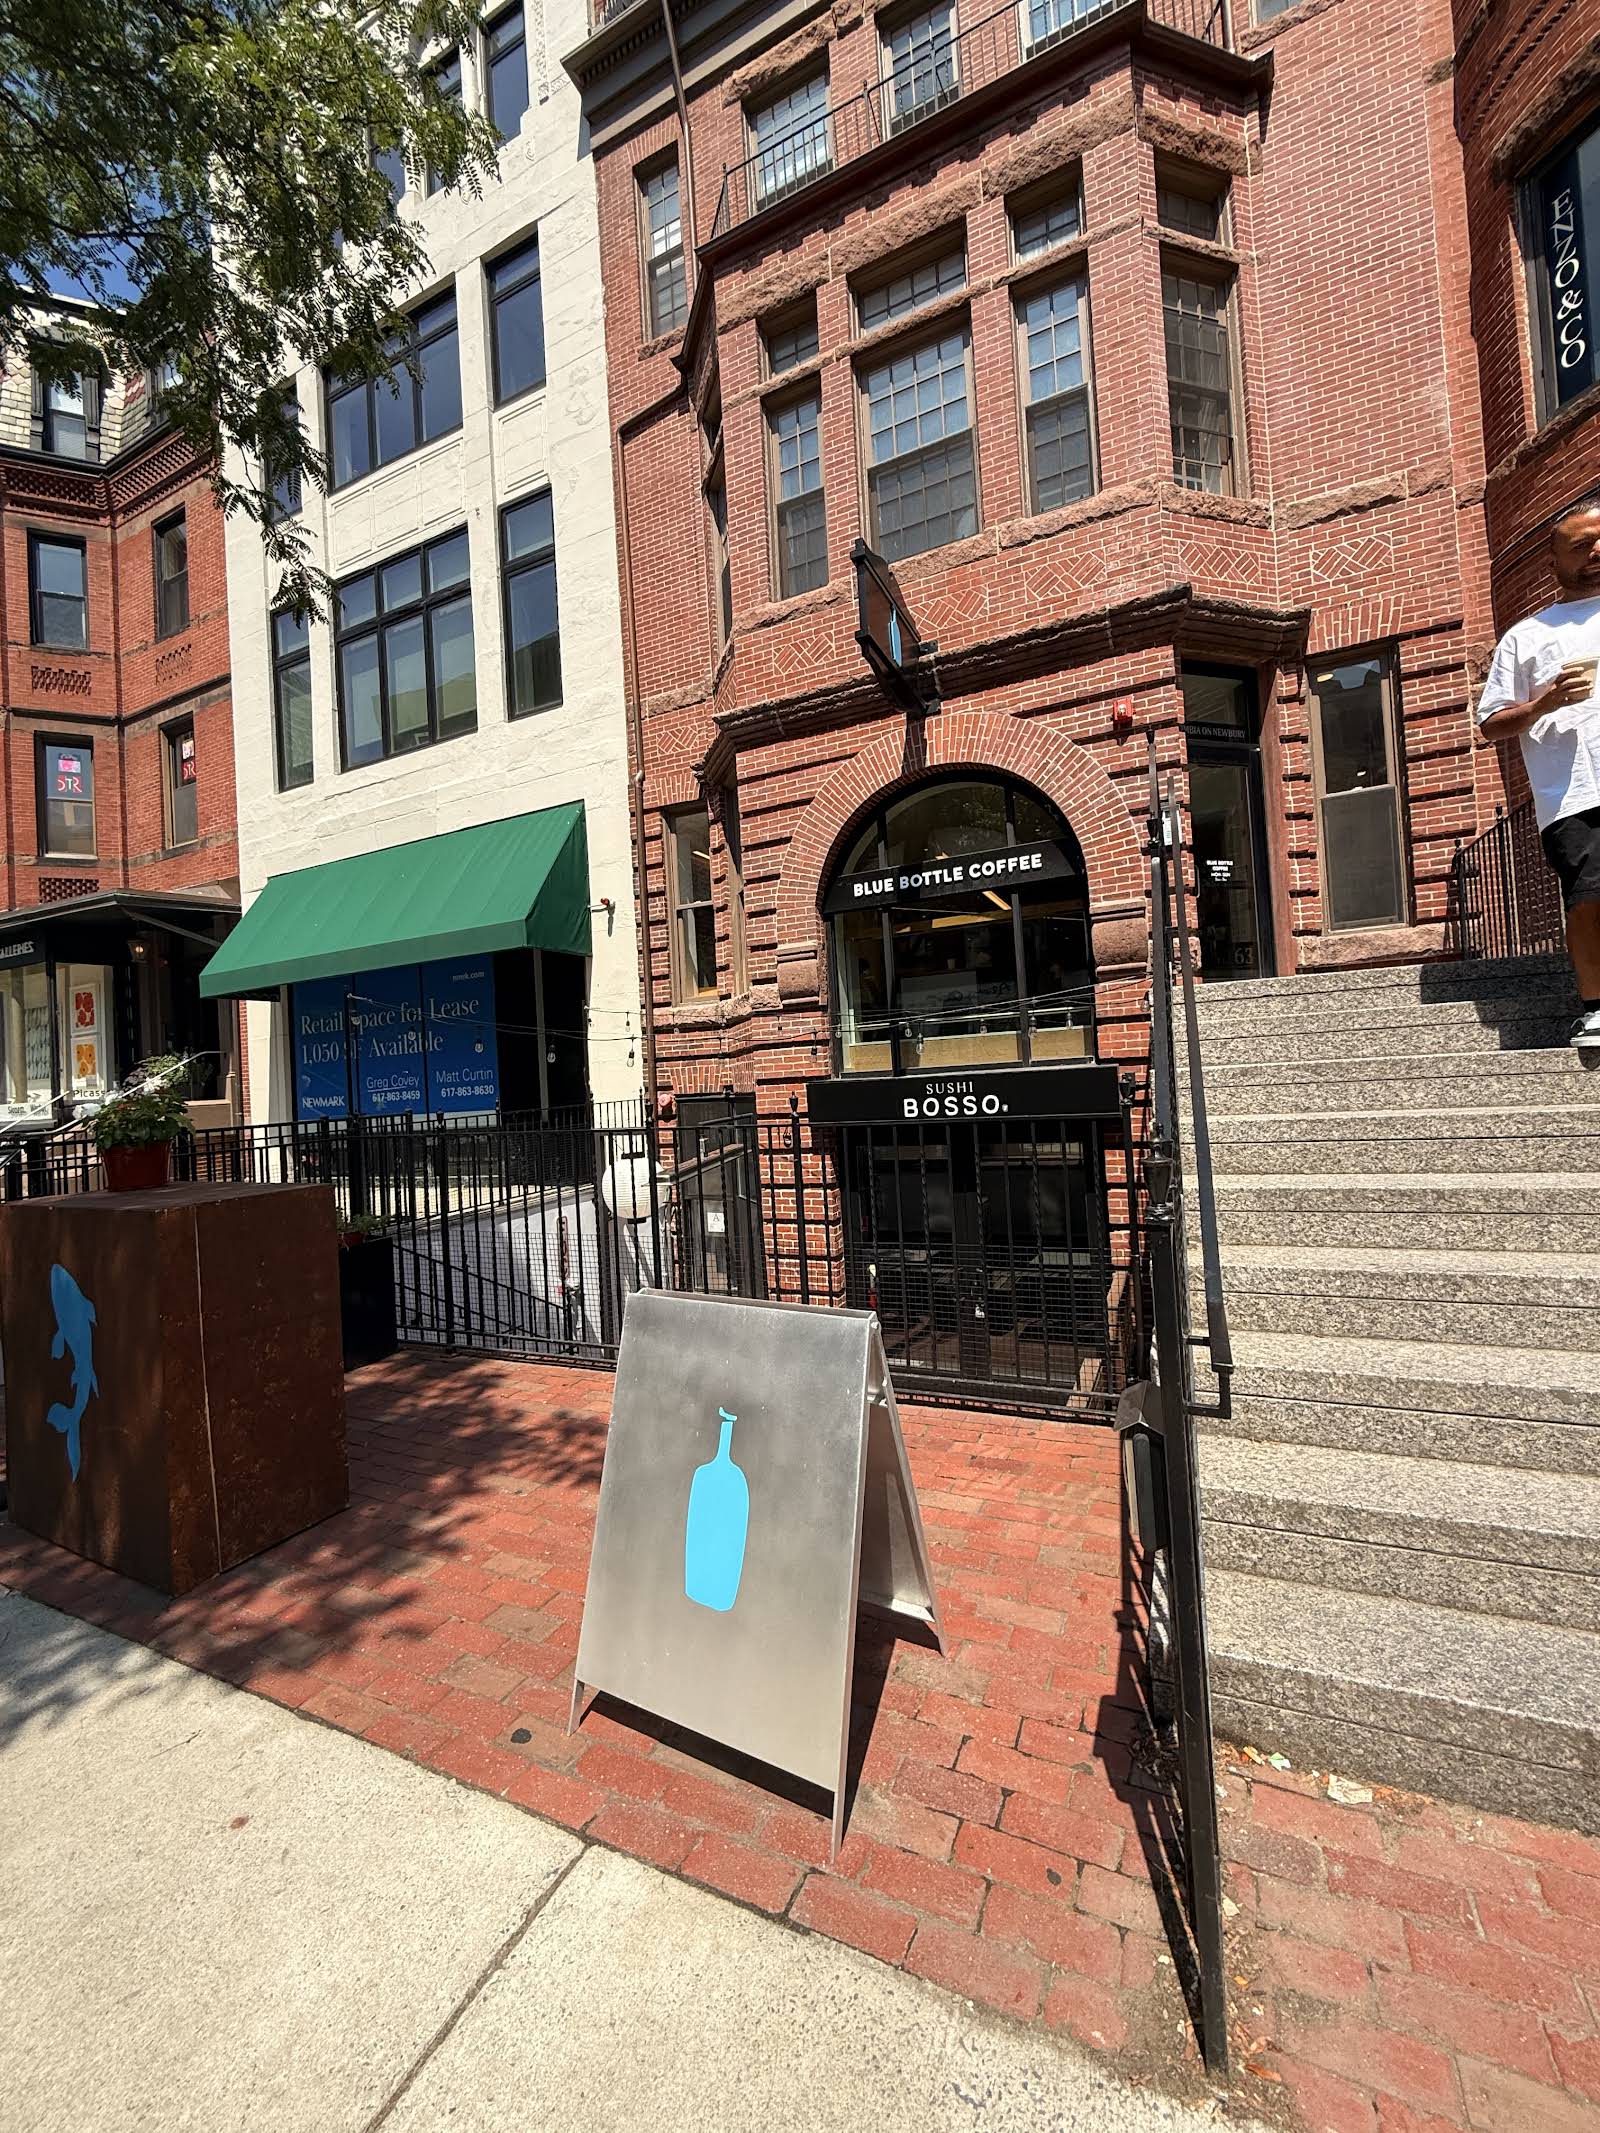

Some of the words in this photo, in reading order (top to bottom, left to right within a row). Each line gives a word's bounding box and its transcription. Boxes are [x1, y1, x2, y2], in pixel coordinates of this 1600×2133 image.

[1212, 727, 1246, 739] NEWBURY
[853, 878, 894, 897] BLUE
[899, 866, 964, 890] BOTTLE
[968, 853, 1043, 879] COFFEE
[301, 1011, 344, 1035] Retail
[350, 1009, 396, 1035] pace
[400, 1001, 423, 1023] for
[430, 998, 479, 1020] Lease
[302, 1040, 339, 1065] 1,050
[369, 1030, 444, 1058] Available
[366, 1076, 389, 1092] Greg
[391, 1074, 420, 1089] Covey
[436, 1069, 459, 1084] Matt
[462, 1067, 493, 1082] Curtin
[441, 1085, 494, 1098] 617-863-8630
[926, 1081, 974, 1095] SUSHI
[302, 1095, 345, 1109] NEWMARK
[372, 1090, 421, 1102] 617-863-8459
